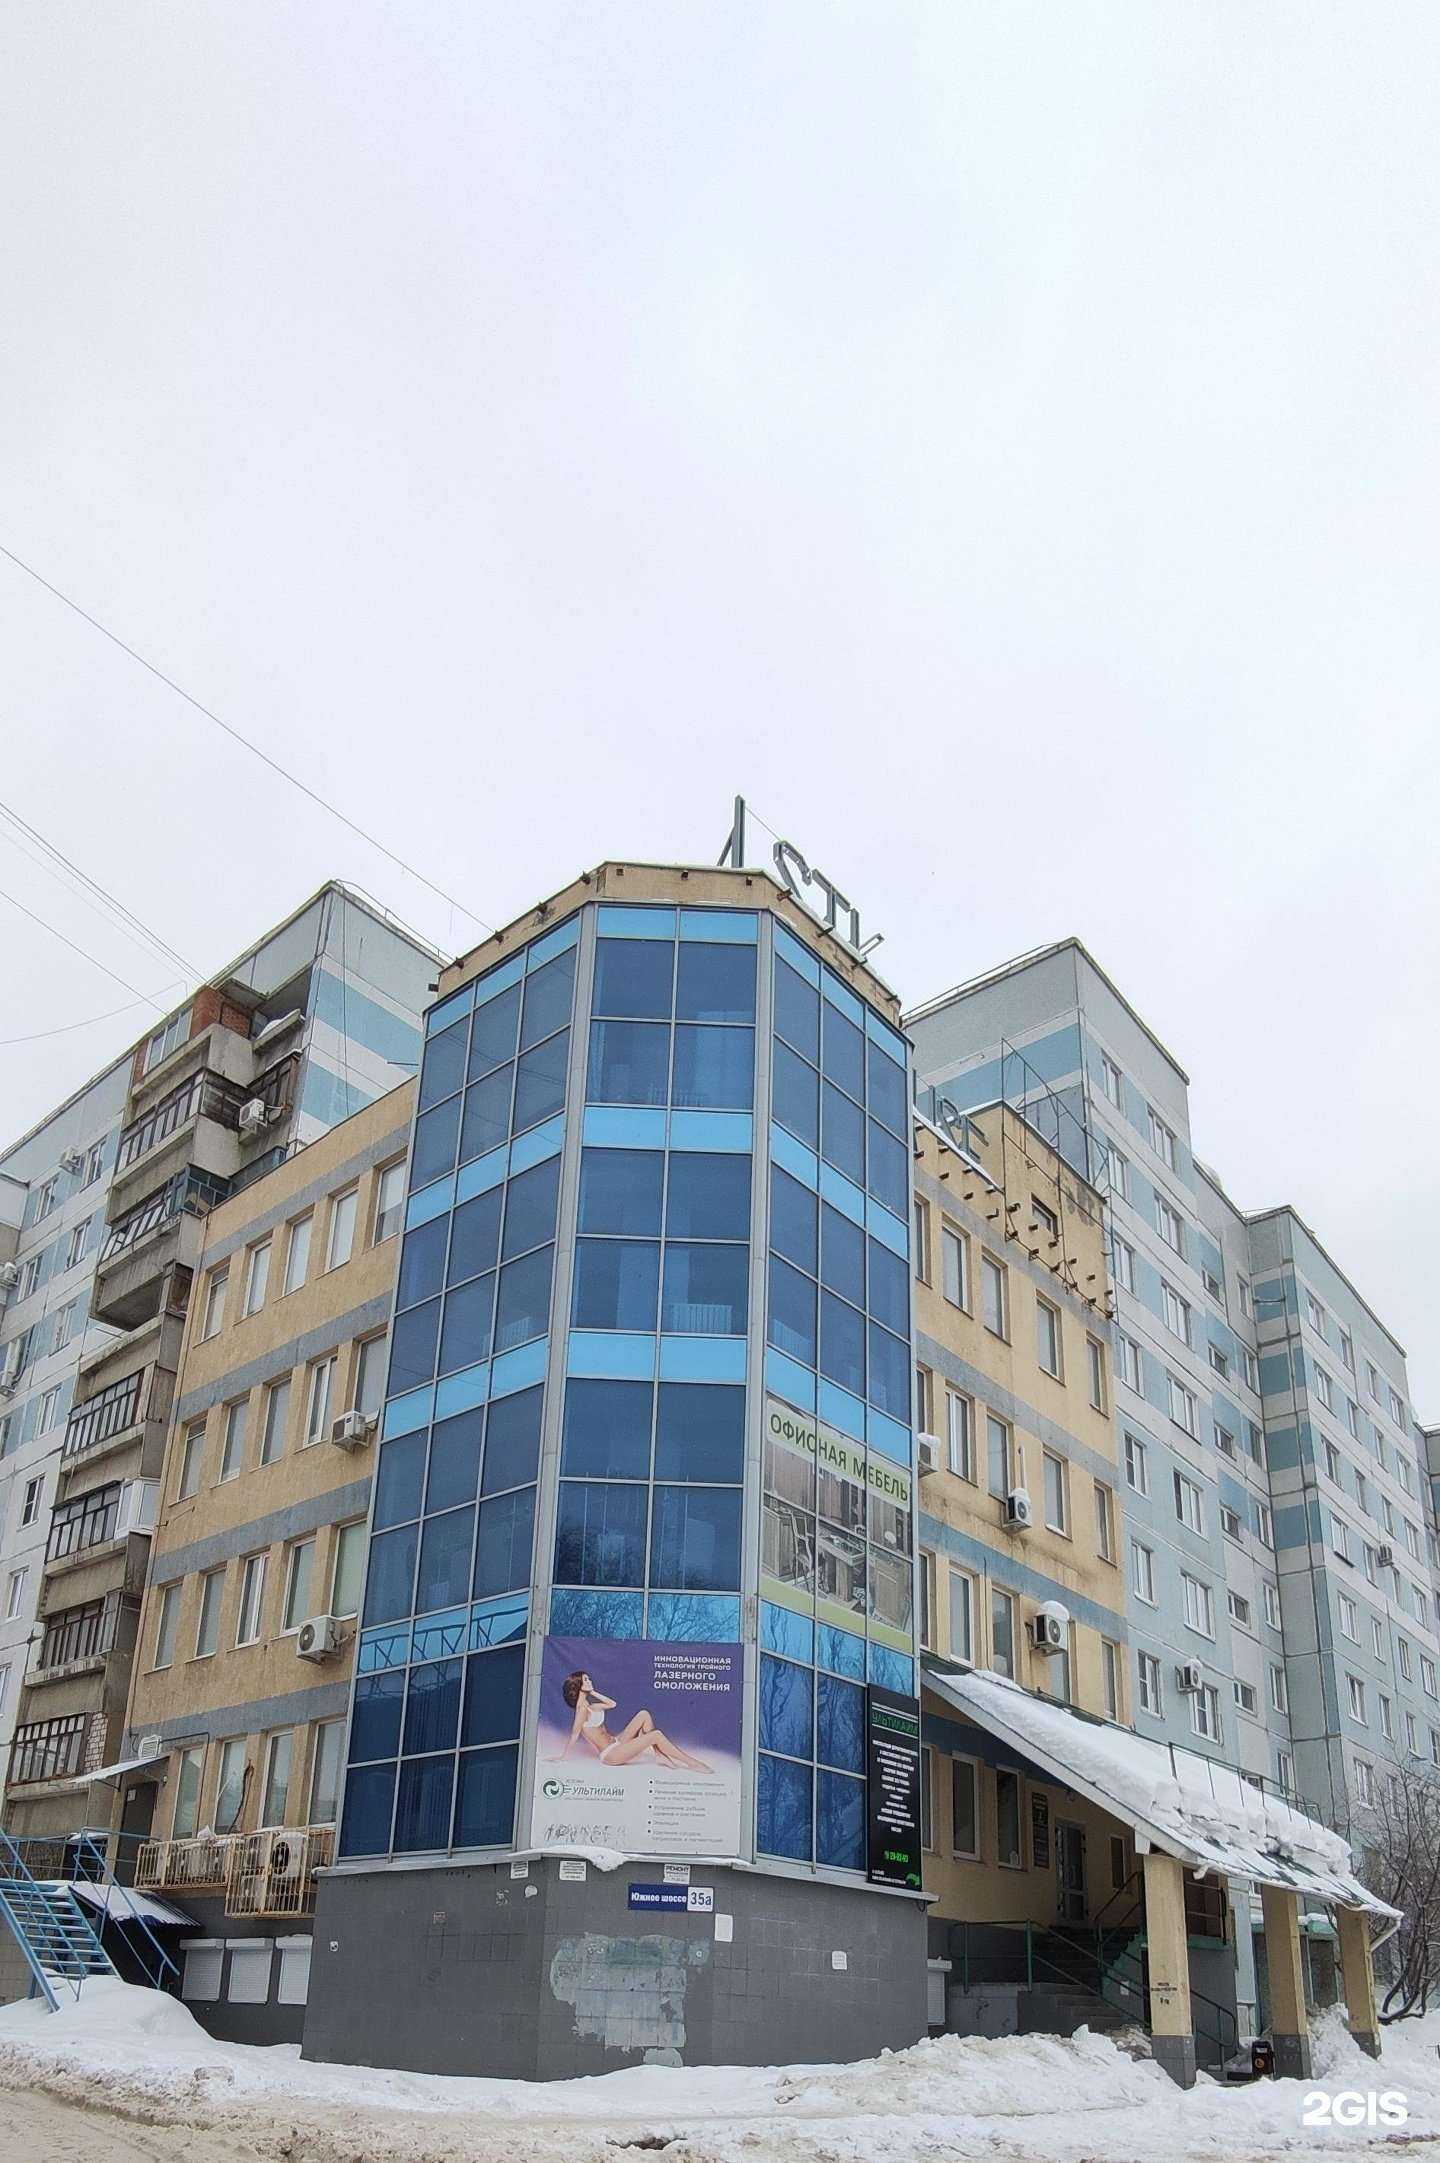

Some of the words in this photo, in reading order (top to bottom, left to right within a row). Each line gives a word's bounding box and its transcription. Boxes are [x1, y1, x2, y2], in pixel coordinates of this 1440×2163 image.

[770, 1414, 847, 1470] ОФИСНАЯ
[853, 1457, 908, 1502] МЕБЕЛЬ
[654, 1655, 731, 1664] ИННОВАЦИОННАЯ
[654, 1671, 716, 1680] ЛАЗЕРНОГО
[654, 1681, 730, 1691] ОМОЛОЖЕНИЯ
[631, 1892, 660, 1902] Южное
[661, 1895, 687, 1903] шоссе
[690, 1892, 712, 1906] 35а
